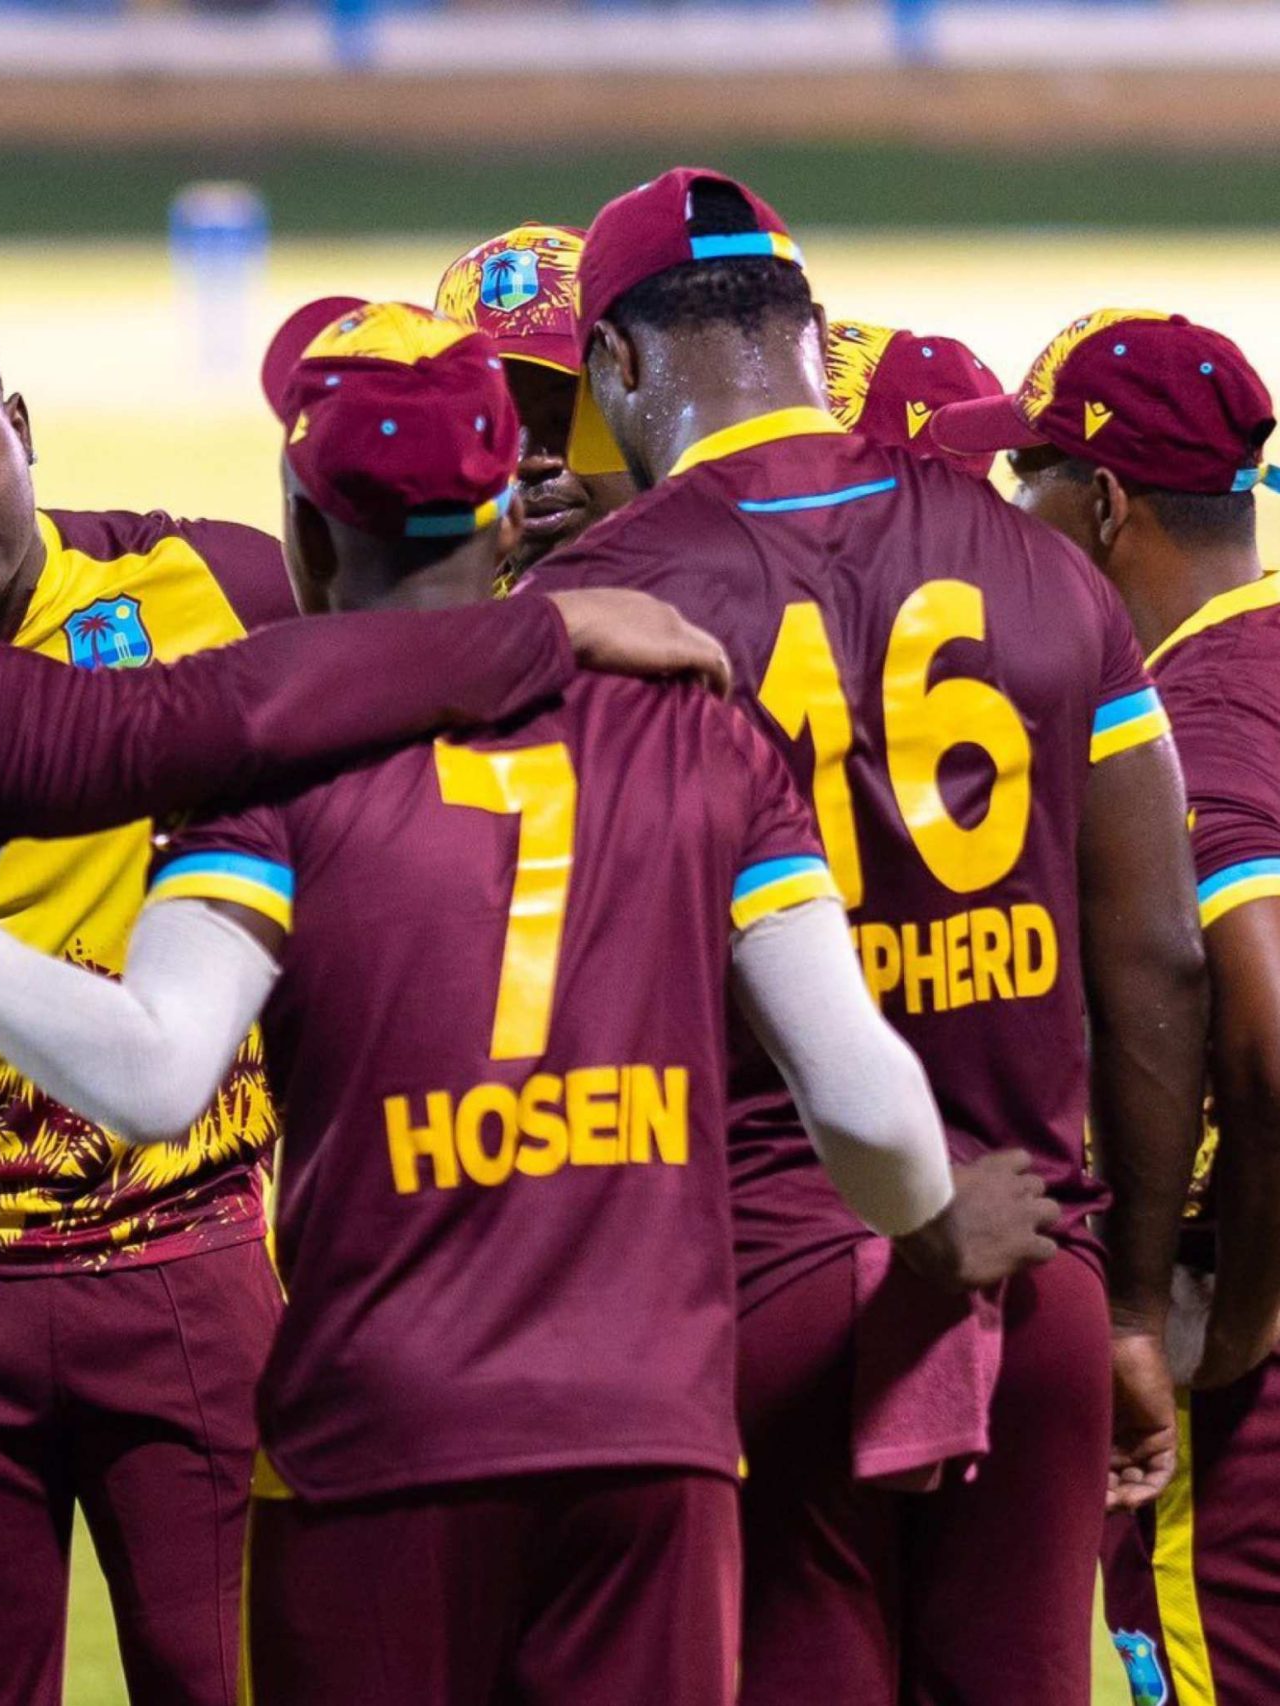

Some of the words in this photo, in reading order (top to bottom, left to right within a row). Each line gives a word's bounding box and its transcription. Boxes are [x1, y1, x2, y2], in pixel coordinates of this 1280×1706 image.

[757, 578, 1032, 912] 16
[433, 737, 578, 1061] 7
[849, 903, 1059, 1018] PHERD
[383, 1063, 689, 1195] HOSEIN
